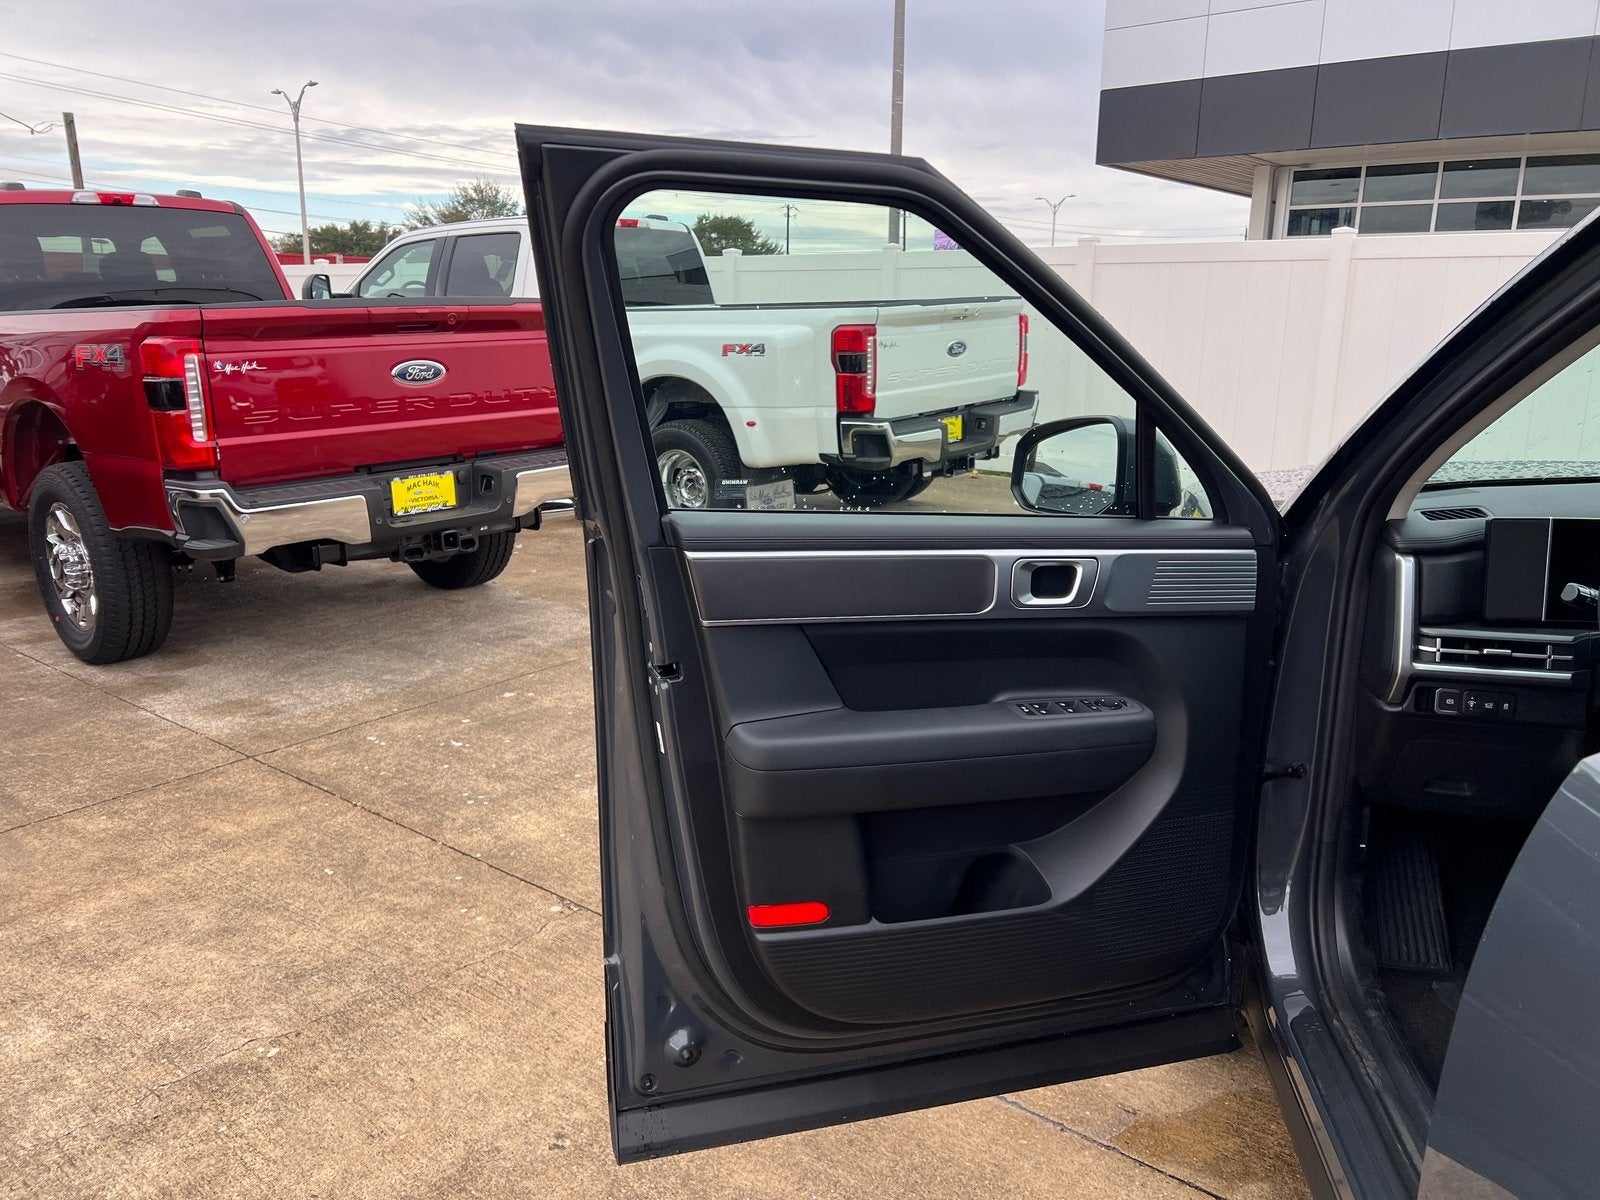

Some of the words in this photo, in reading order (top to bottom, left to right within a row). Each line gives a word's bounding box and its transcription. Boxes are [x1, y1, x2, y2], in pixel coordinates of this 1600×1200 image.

[75, 344, 124, 370] FX4
[721, 343, 766, 357] FX4
[887, 364, 963, 384] SUPER
[243, 396, 435, 425] SUPER
[449, 386, 556, 408] DUTY
[407, 480, 422, 492] MAC
[410, 495, 439, 503] VICTORIA
